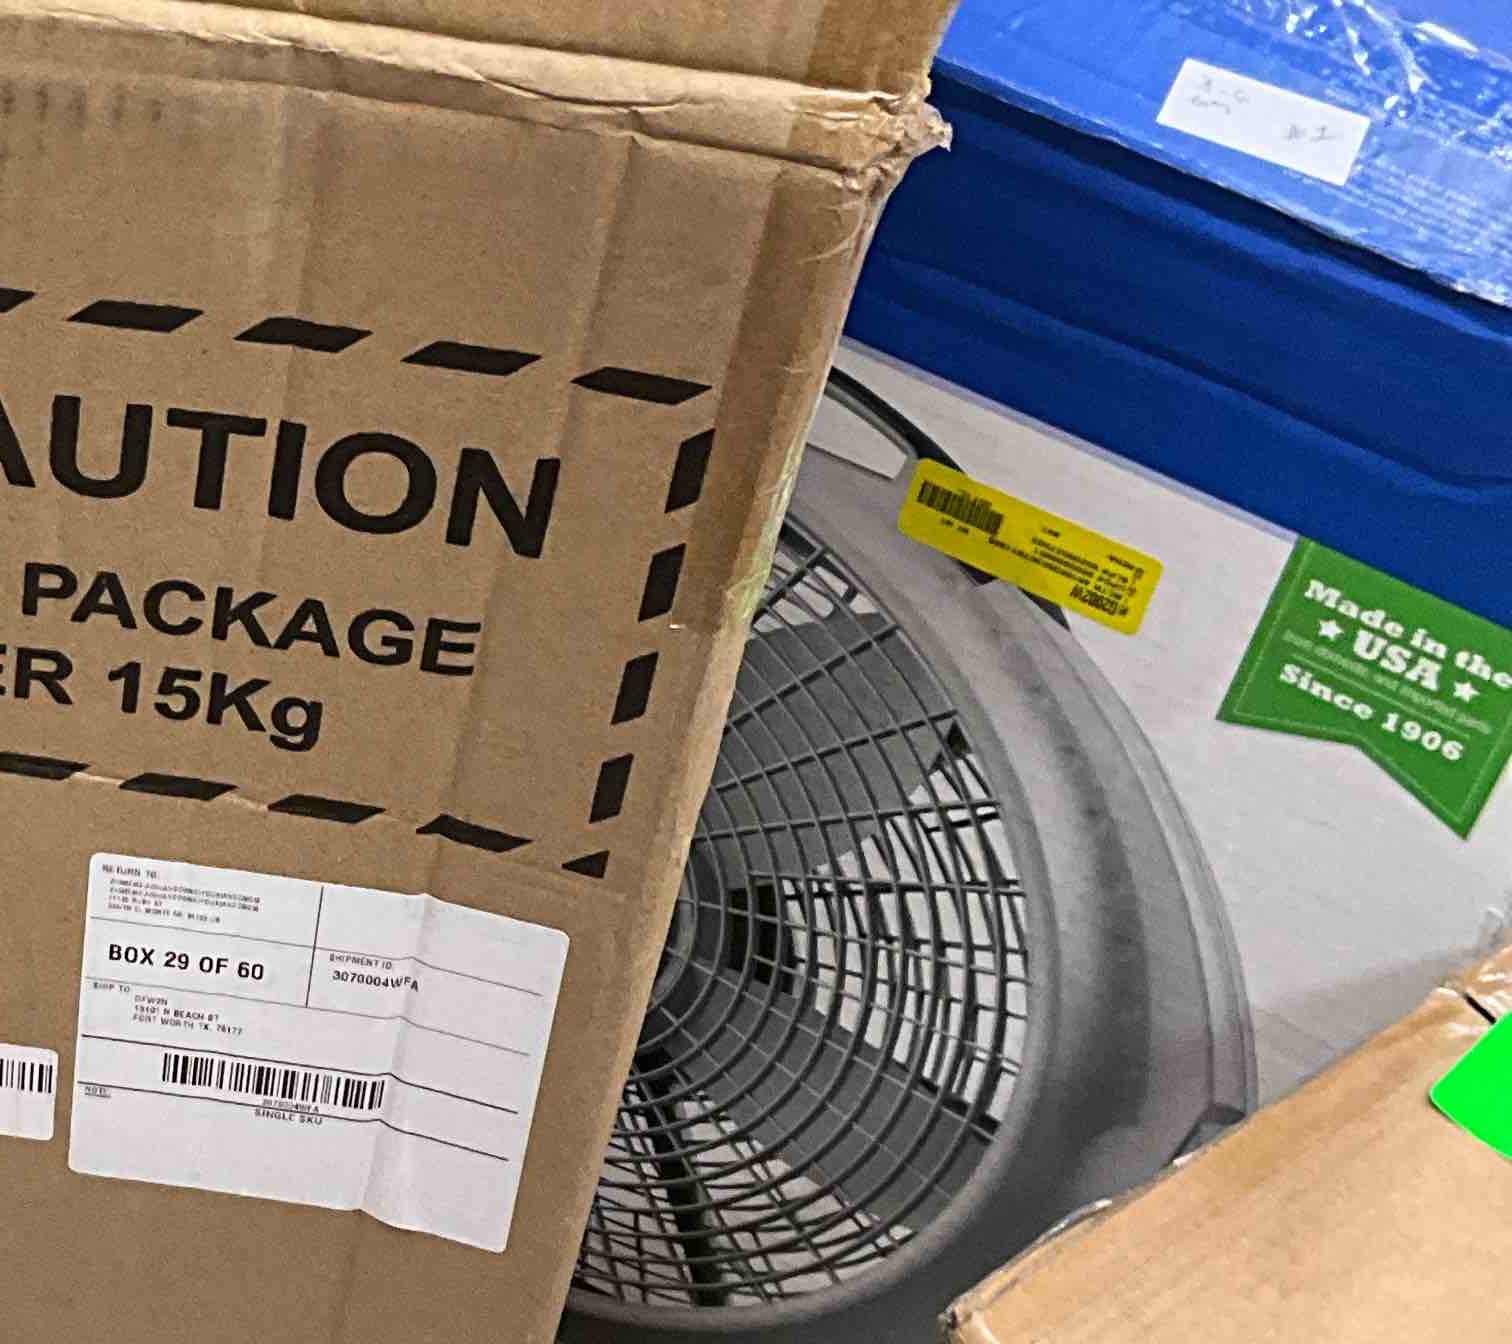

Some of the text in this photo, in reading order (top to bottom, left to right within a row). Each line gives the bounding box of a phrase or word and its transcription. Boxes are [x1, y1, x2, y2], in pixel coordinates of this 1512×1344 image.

[22, 562, 483, 677] PACKAGE
[1304, 578, 1512, 689] Made in the
[1352, 628, 1444, 692] USA
[108, 660, 324, 754] 15Kg
[1278, 662, 1374, 721] Since
[1381, 712, 1465, 762] 1906
[108, 944, 265, 981] BOX 29 OF 60
